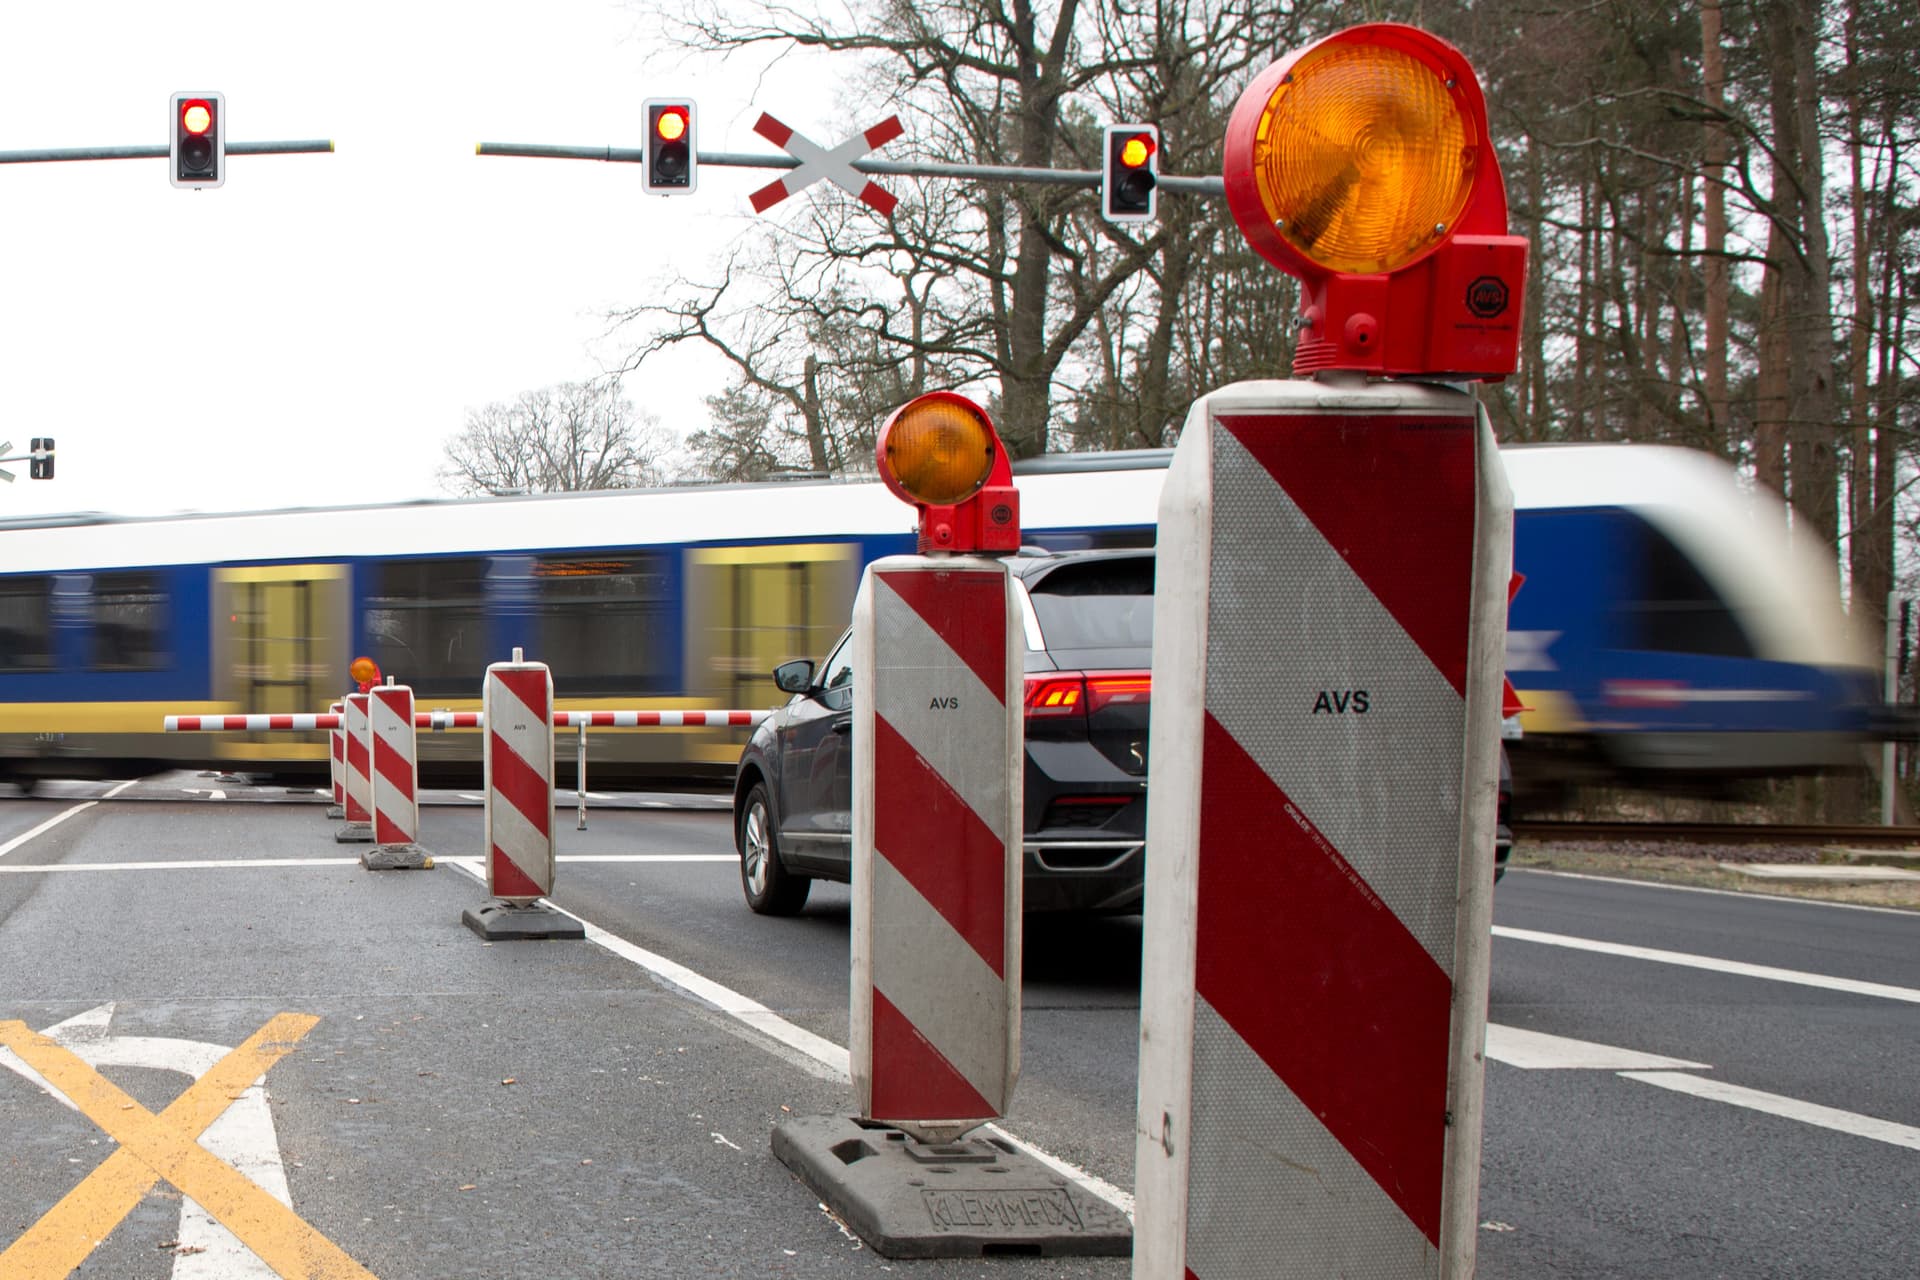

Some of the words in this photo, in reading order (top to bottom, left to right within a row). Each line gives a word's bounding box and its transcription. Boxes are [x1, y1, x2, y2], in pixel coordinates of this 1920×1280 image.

[929, 697, 958, 710] AVS
[1312, 690, 1369, 714] AVS
[924, 1198, 1079, 1226] KLEMMFIX
